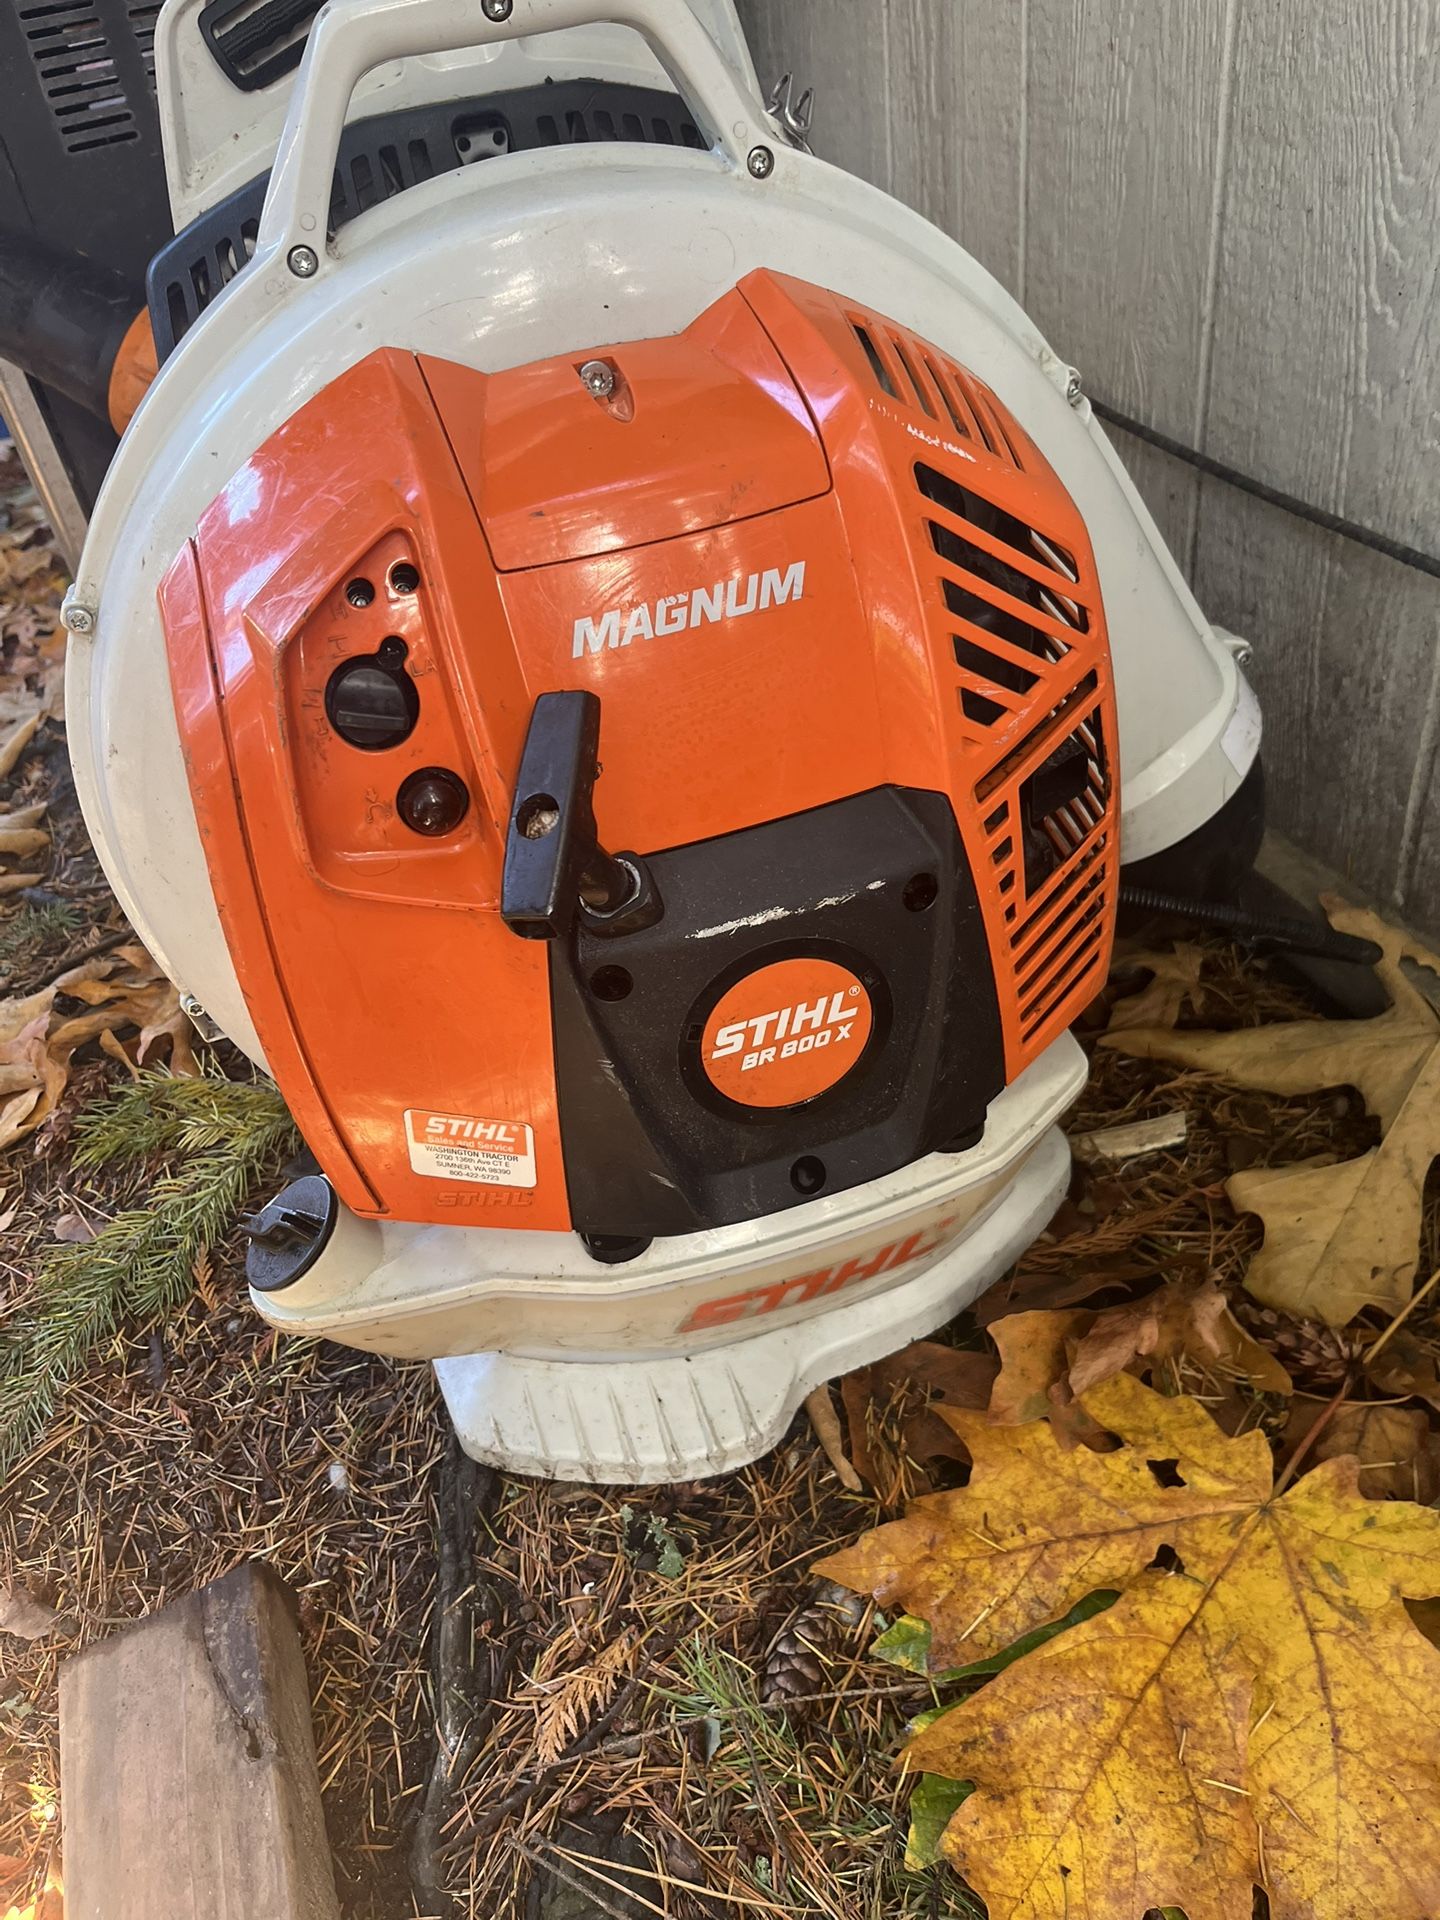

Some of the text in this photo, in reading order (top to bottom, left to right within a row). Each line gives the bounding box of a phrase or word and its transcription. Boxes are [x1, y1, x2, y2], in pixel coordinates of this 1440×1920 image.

[572, 560, 806, 659] MAGNUM
[741, 1022, 854, 1072] BR 800 X
[427, 1135, 514, 1153] Sales and Service
[425, 1145, 519, 1162] WASHINGTON TRACTOR
[435, 1153, 453, 1162] 2700
[477, 1158, 491, 1166] Ave
[474, 1165, 487, 1173] WA
